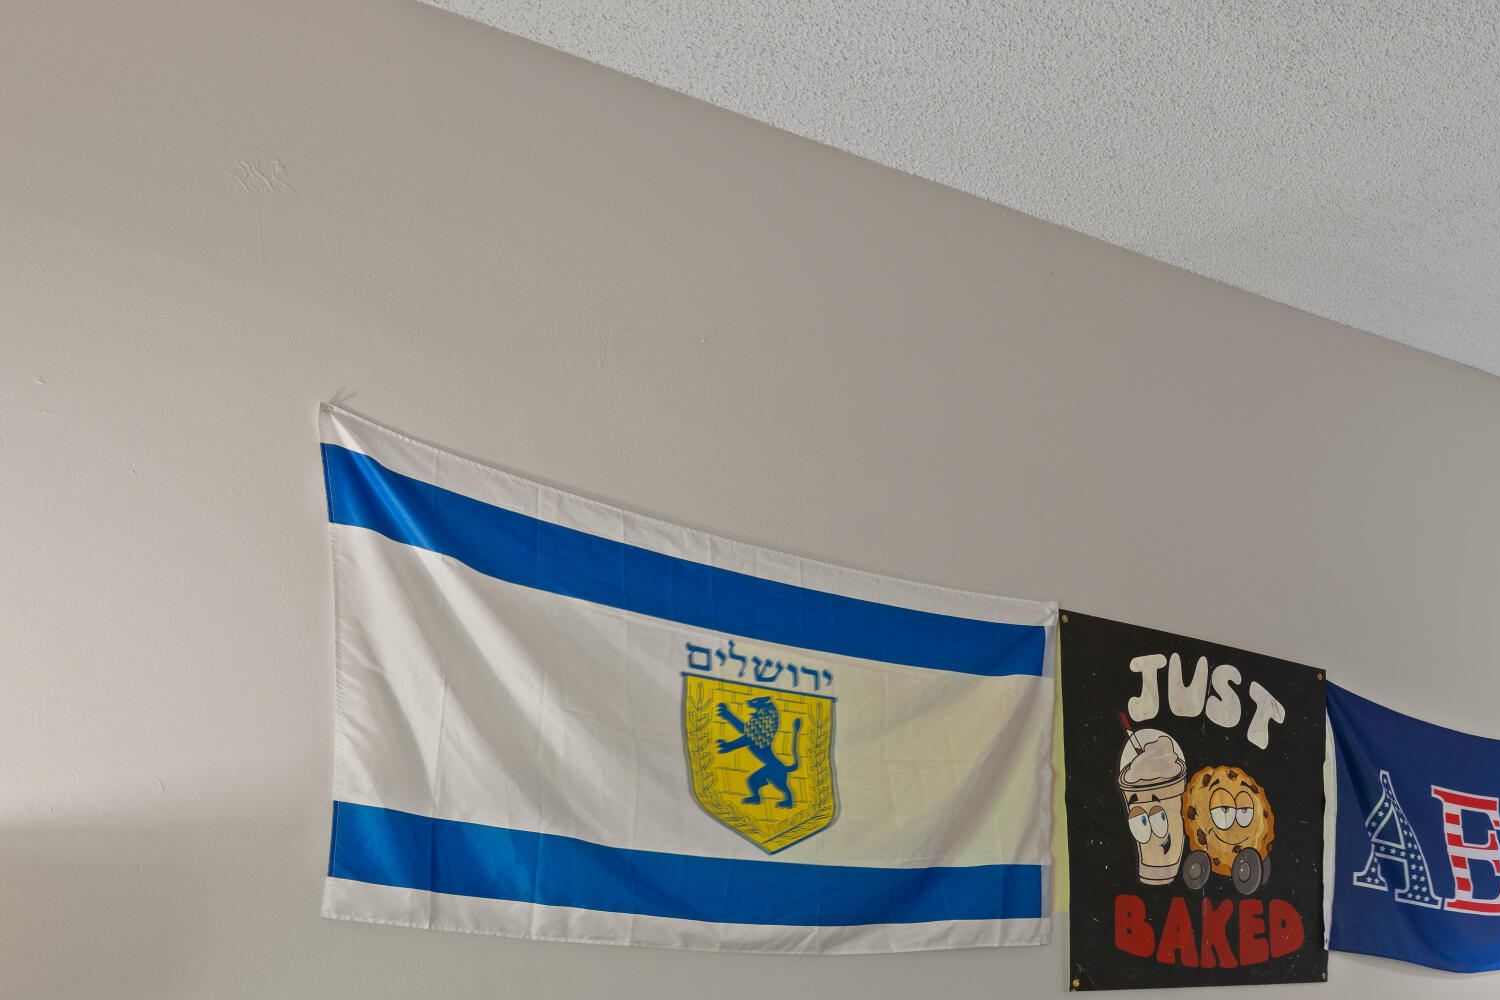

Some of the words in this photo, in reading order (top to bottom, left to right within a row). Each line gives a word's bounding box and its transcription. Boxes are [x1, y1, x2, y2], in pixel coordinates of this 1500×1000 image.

[684, 640, 834, 691] ירושלים
[1127, 651, 1286, 750] JUST
[1113, 892, 1305, 969] BAKED
